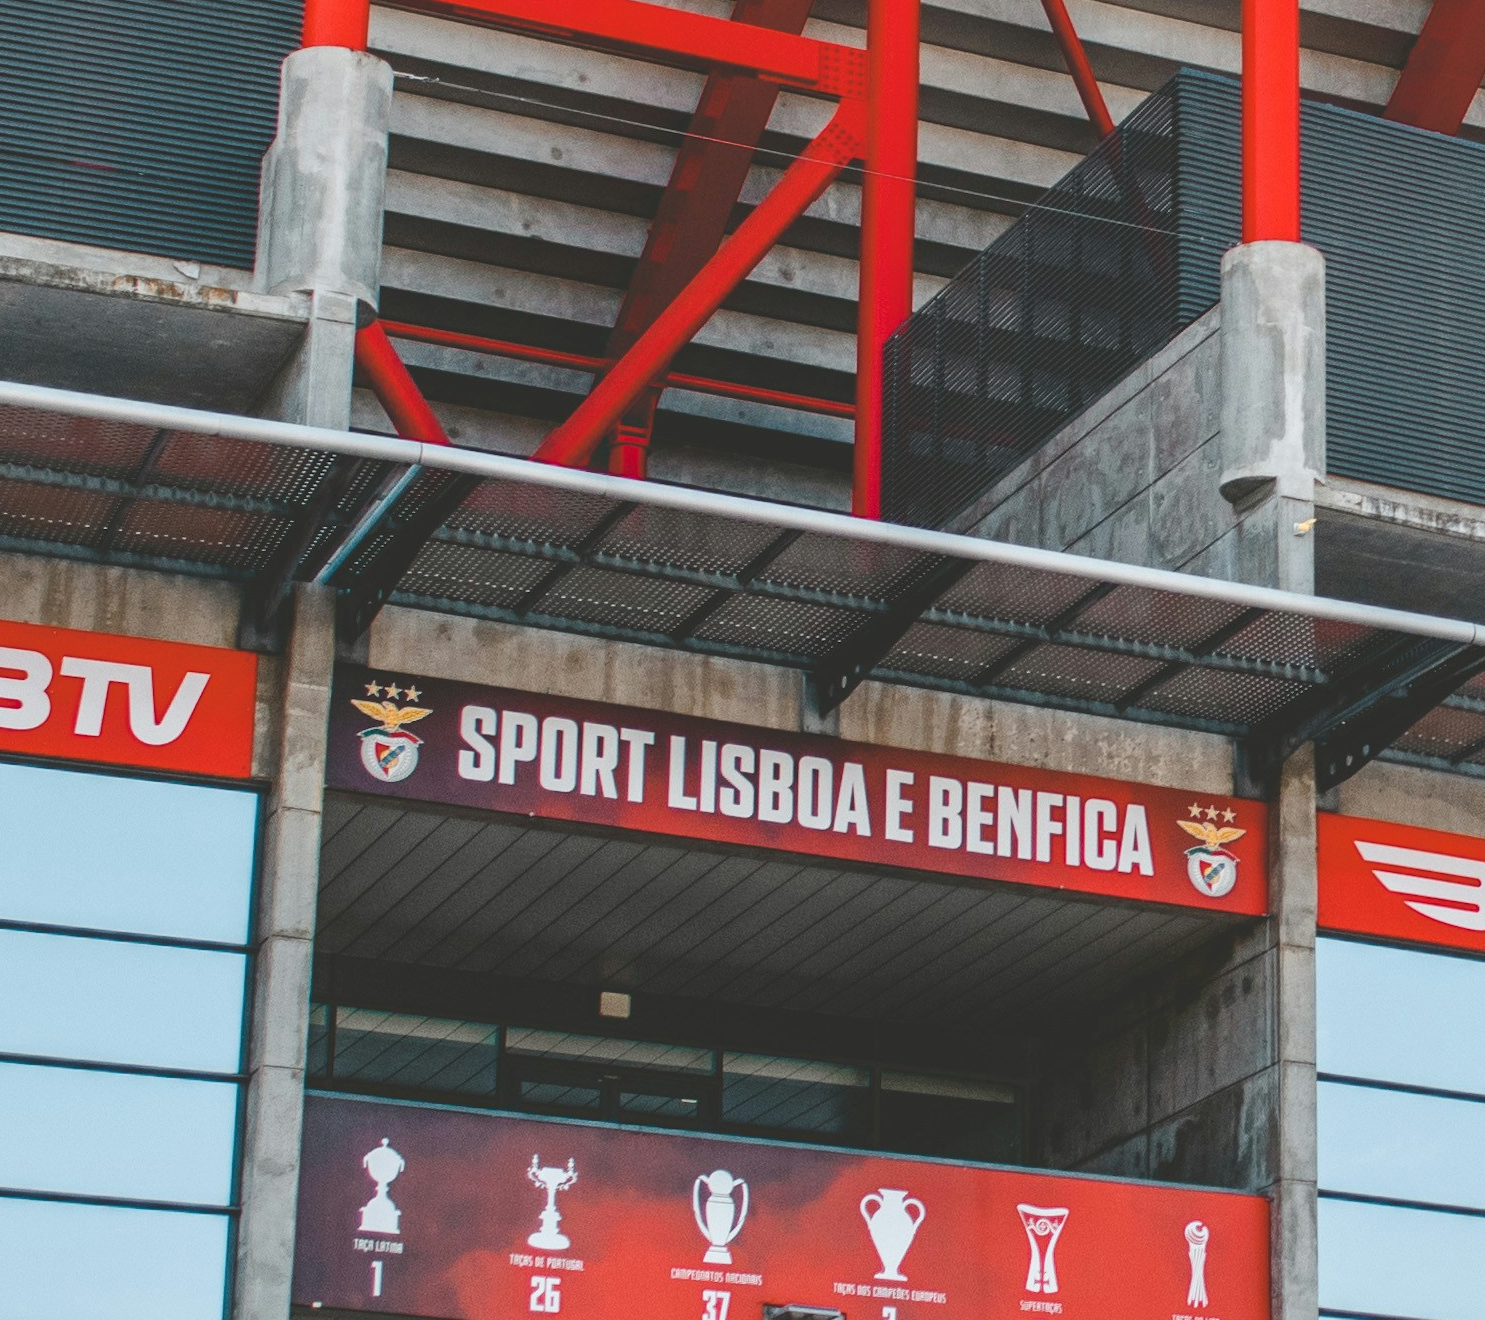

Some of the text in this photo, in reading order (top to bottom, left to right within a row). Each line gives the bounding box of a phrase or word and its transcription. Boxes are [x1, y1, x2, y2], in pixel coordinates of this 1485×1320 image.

[457, 705, 1156, 877] SPORT LISBOA E BENFICA
[354, 1238, 404, 1254] TAÇA LATINA
[509, 1253, 584, 1271] TAÇAS DE PORTUGAL
[371, 1260, 383, 1297] 1
[671, 1268, 724, 1283] CAMPEONATOS
[529, 1275, 562, 1314] 26
[833, 1282, 856, 1296] TAÇAS
[1019, 1300, 1063, 1315] SUPERTAÇAS
